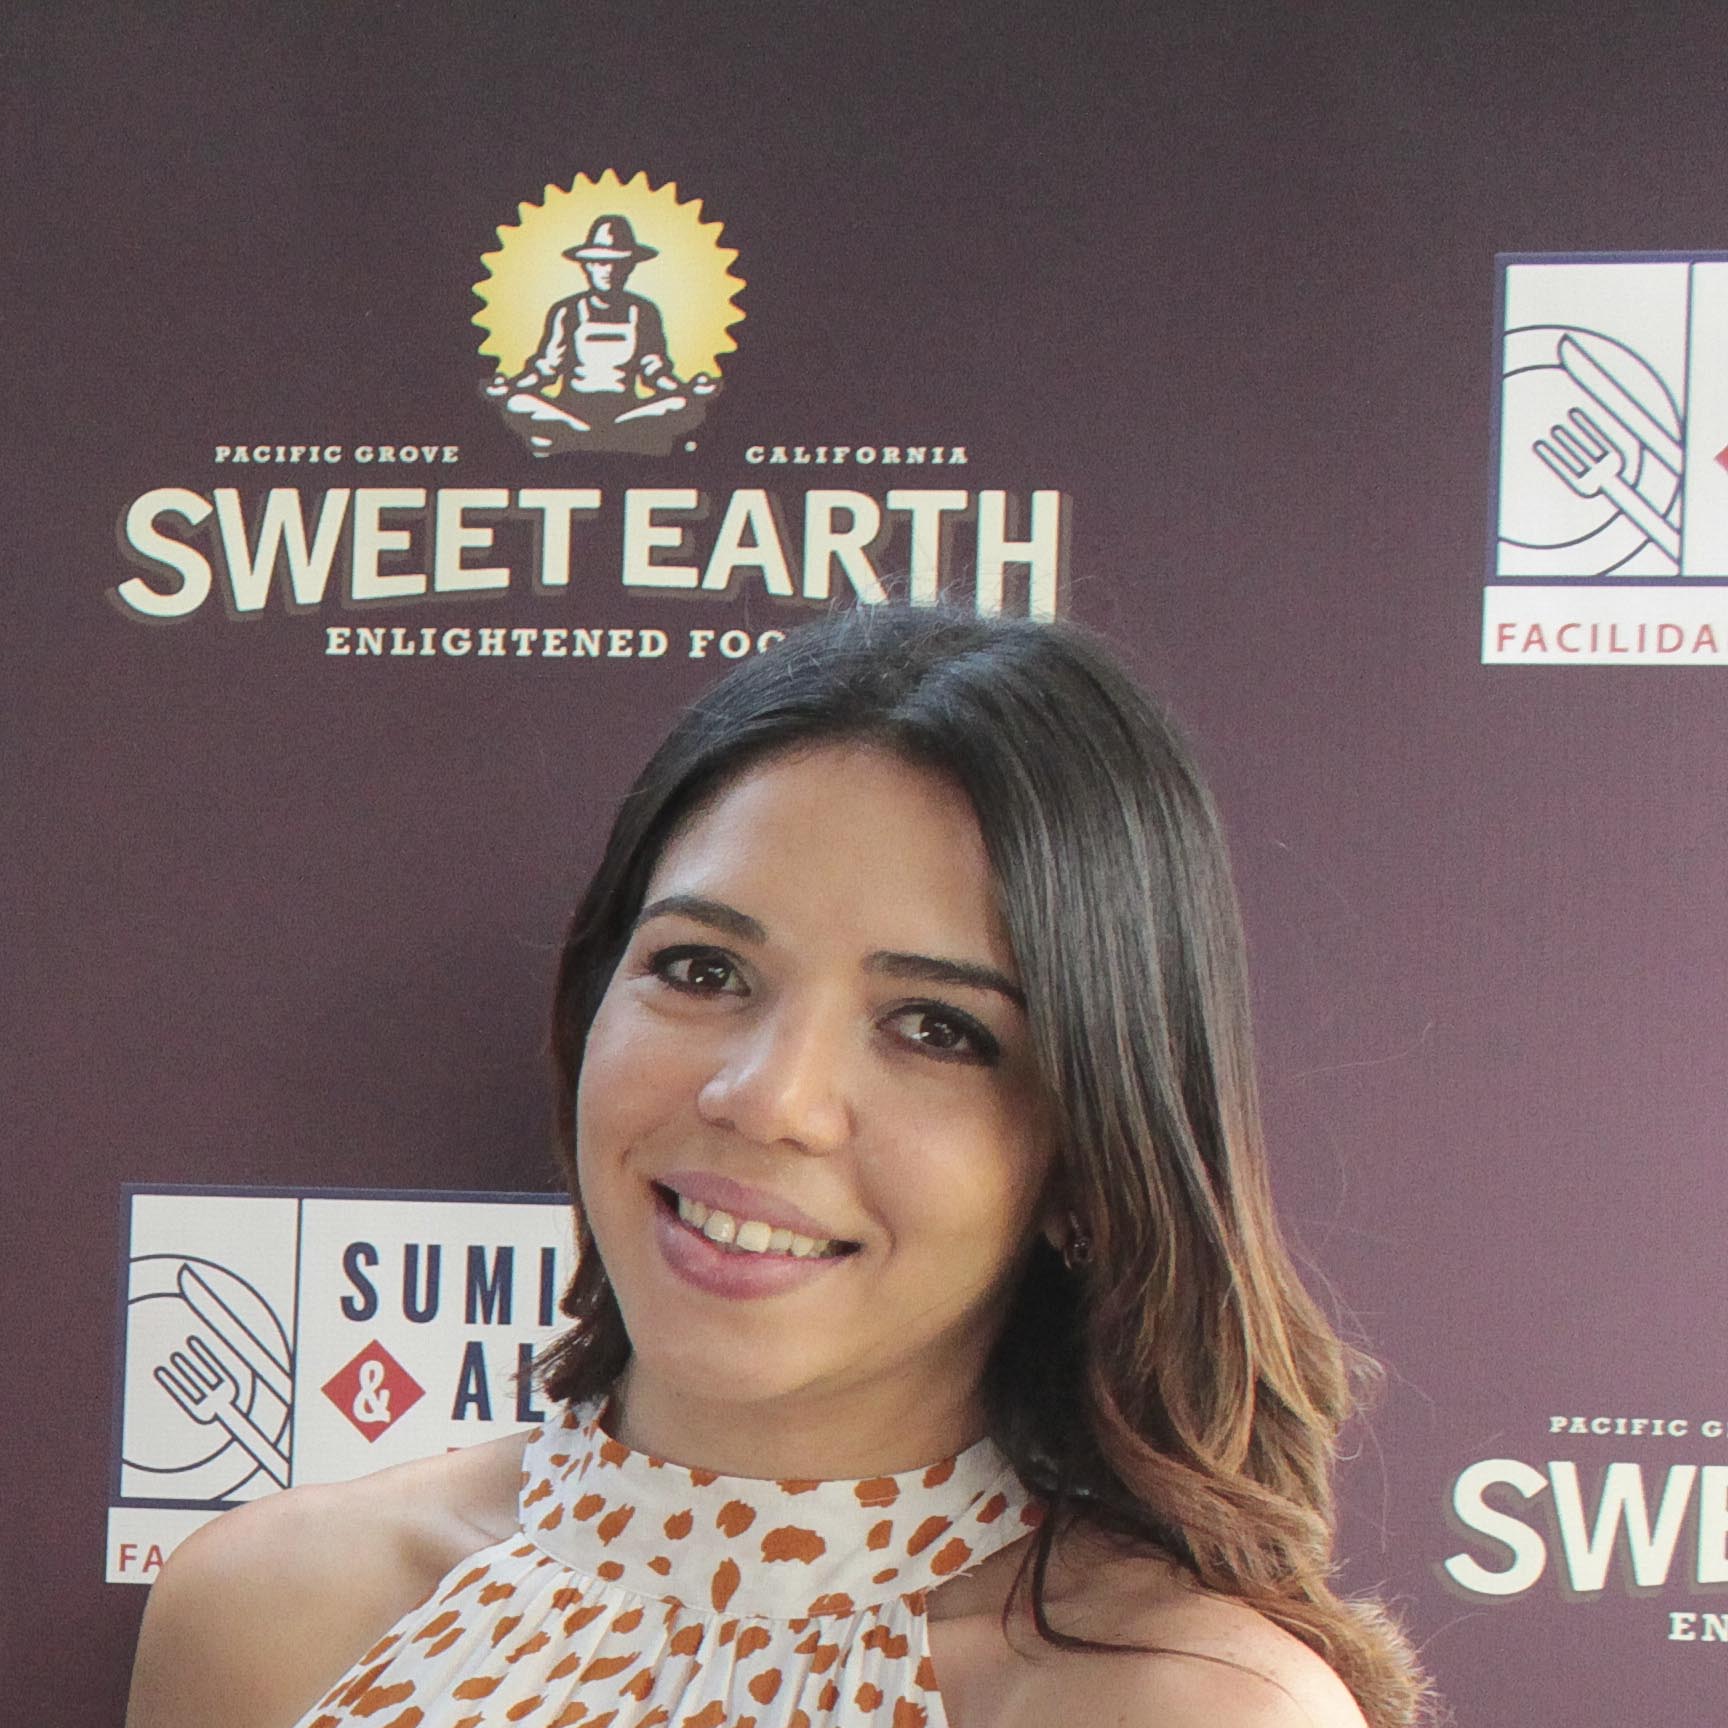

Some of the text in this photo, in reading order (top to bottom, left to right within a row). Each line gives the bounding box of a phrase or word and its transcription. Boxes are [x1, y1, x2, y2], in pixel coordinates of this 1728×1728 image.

[215, 445, 459, 464] PACIFIC GROVE
[745, 446, 968, 466] CALIFORNIA
[118, 488, 1060, 626] SWEET EARTH
[325, 627, 670, 658] ENLIGHTENED
[1496, 622, 1718, 653] FACILIDA
[354, 1361, 391, 1424] &
[1549, 1416, 1688, 1435] PACIFIC
